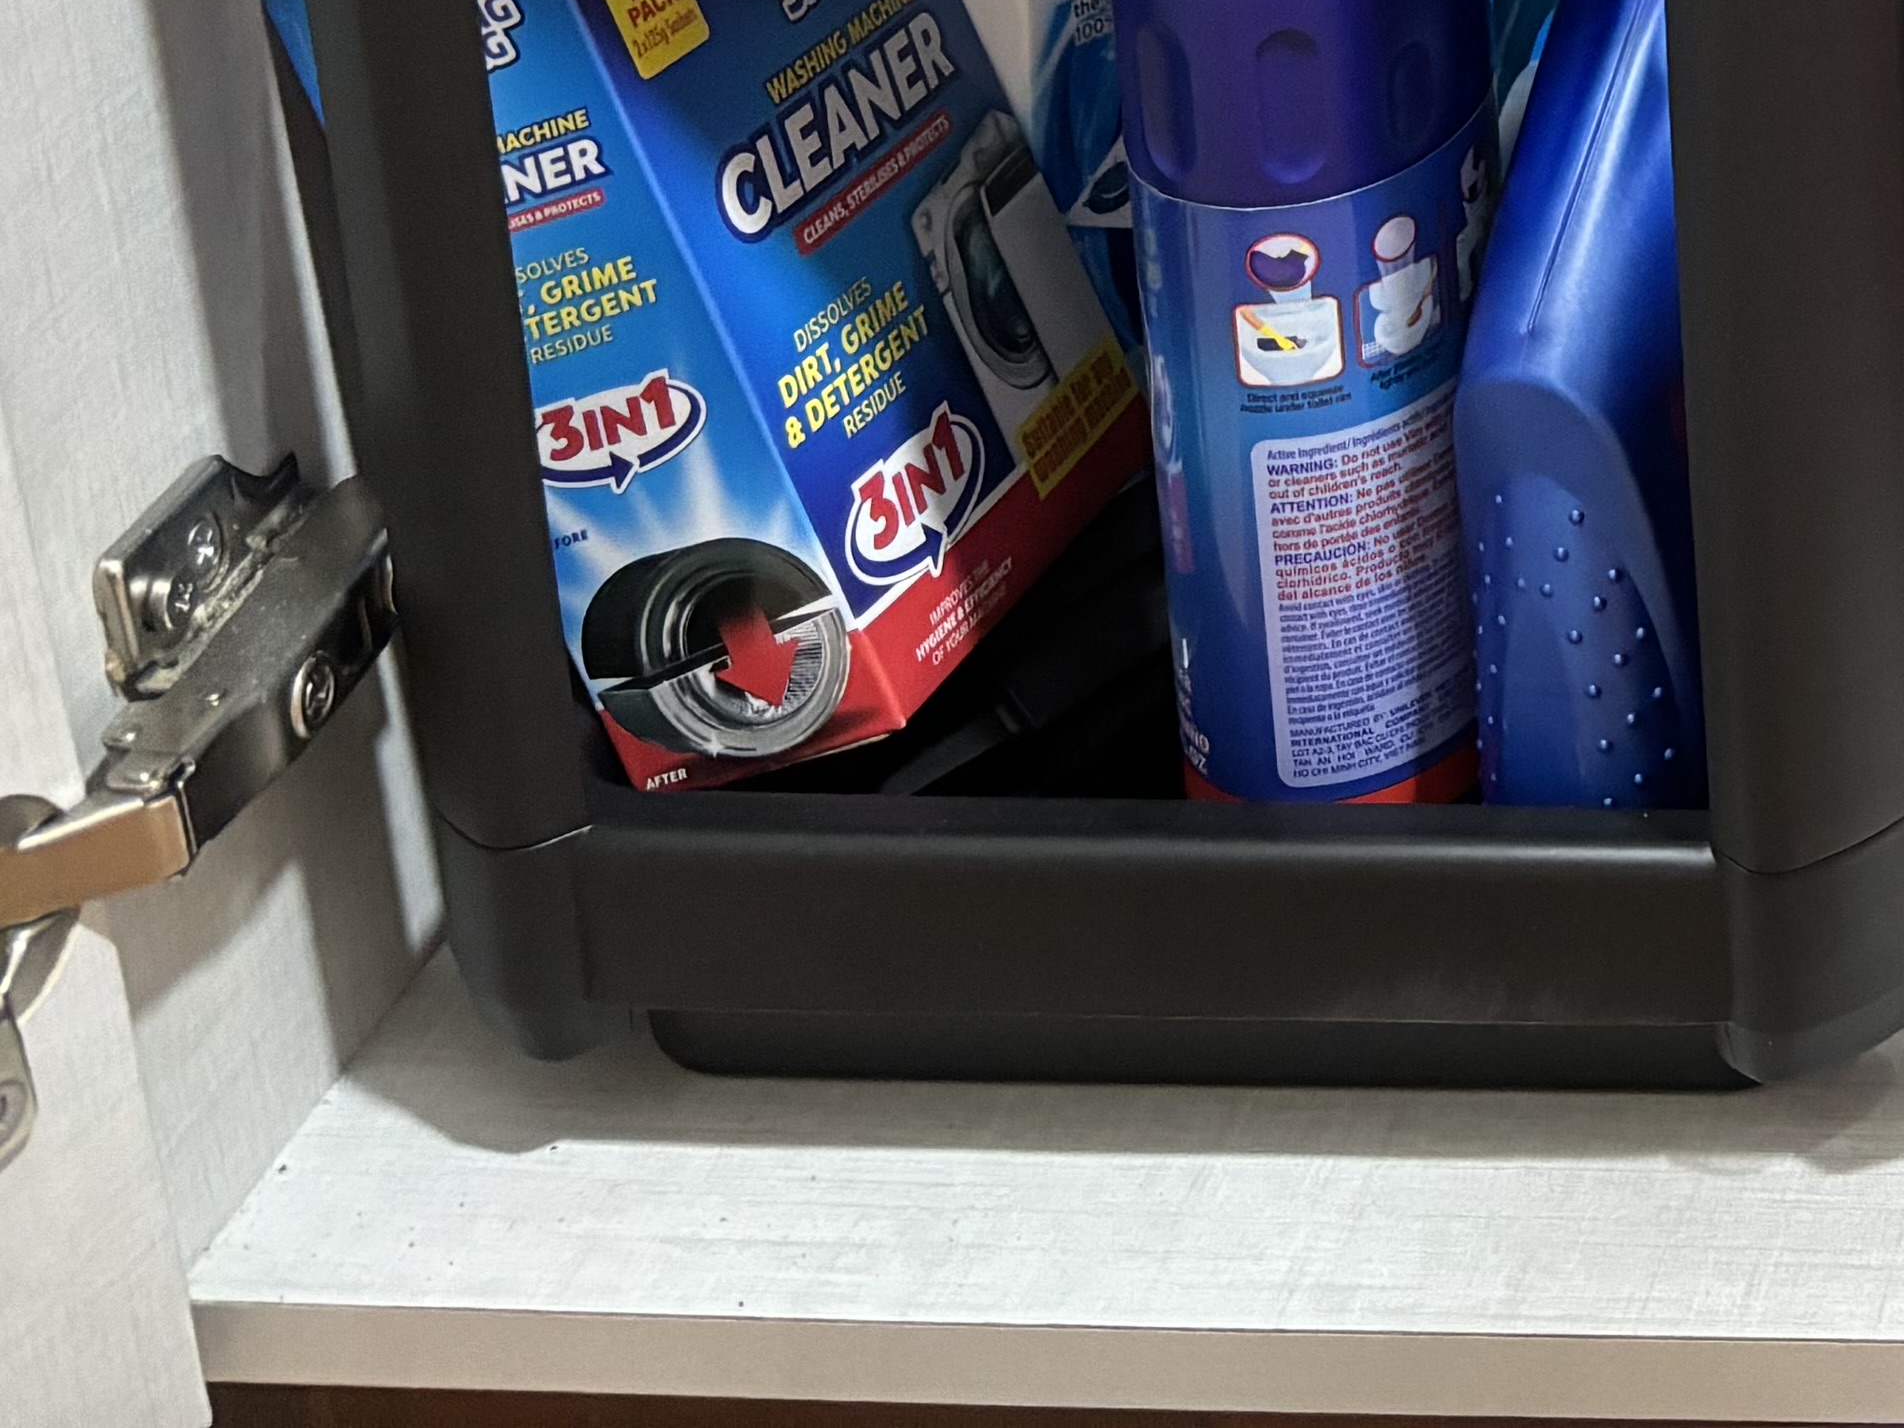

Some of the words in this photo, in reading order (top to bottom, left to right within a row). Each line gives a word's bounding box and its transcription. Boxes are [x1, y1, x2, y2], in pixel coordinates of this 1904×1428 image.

[766, 31, 848, 104] WASHING
[722, 10, 956, 234] CLEANER
[544, 192, 601, 219] PROTECTS
[803, 204, 849, 245] CLEANS,
[539, 255, 637, 306] GRIME
[794, 276, 872, 353] DISSOLVES
[530, 324, 614, 365] RESIDUE
[778, 343, 843, 409] DIRT,
[841, 281, 910, 355] GRIME
[785, 416, 806, 448] &
[804, 305, 930, 432] DETERGENT
[541, 375, 676, 463] 3IN1
[843, 371, 907, 439] RESIDUE
[859, 410, 965, 551] 3IN1
[1266, 460, 1339, 476] WARNING:
[1341, 452, 1358, 466] Do
[1361, 448, 1381, 461] not
[1268, 477, 1281, 488] or
[1284, 469, 1338, 487] cleaners
[1340, 462, 1370, 479] such
[1371, 459, 1387, 470] as
[1268, 488, 1290, 500] out
[1292, 486, 1307, 498] of
[1309, 474, 1369, 496] children's
[1270, 493, 1353, 514] ATTENTION:
[1356, 488, 1372, 500] Ne
[1375, 480, 1397, 496] pas
[1271, 516, 1300, 527] avec
[1303, 538, 1319, 549] de
[1274, 541, 1371, 566] PRECAUCIÓN:
[1374, 535, 1390, 547] No
[929, 578, 975, 626] IMPROVES
[915, 611, 959, 663] HYGIENE
[645, 767, 688, 791] AFTER
